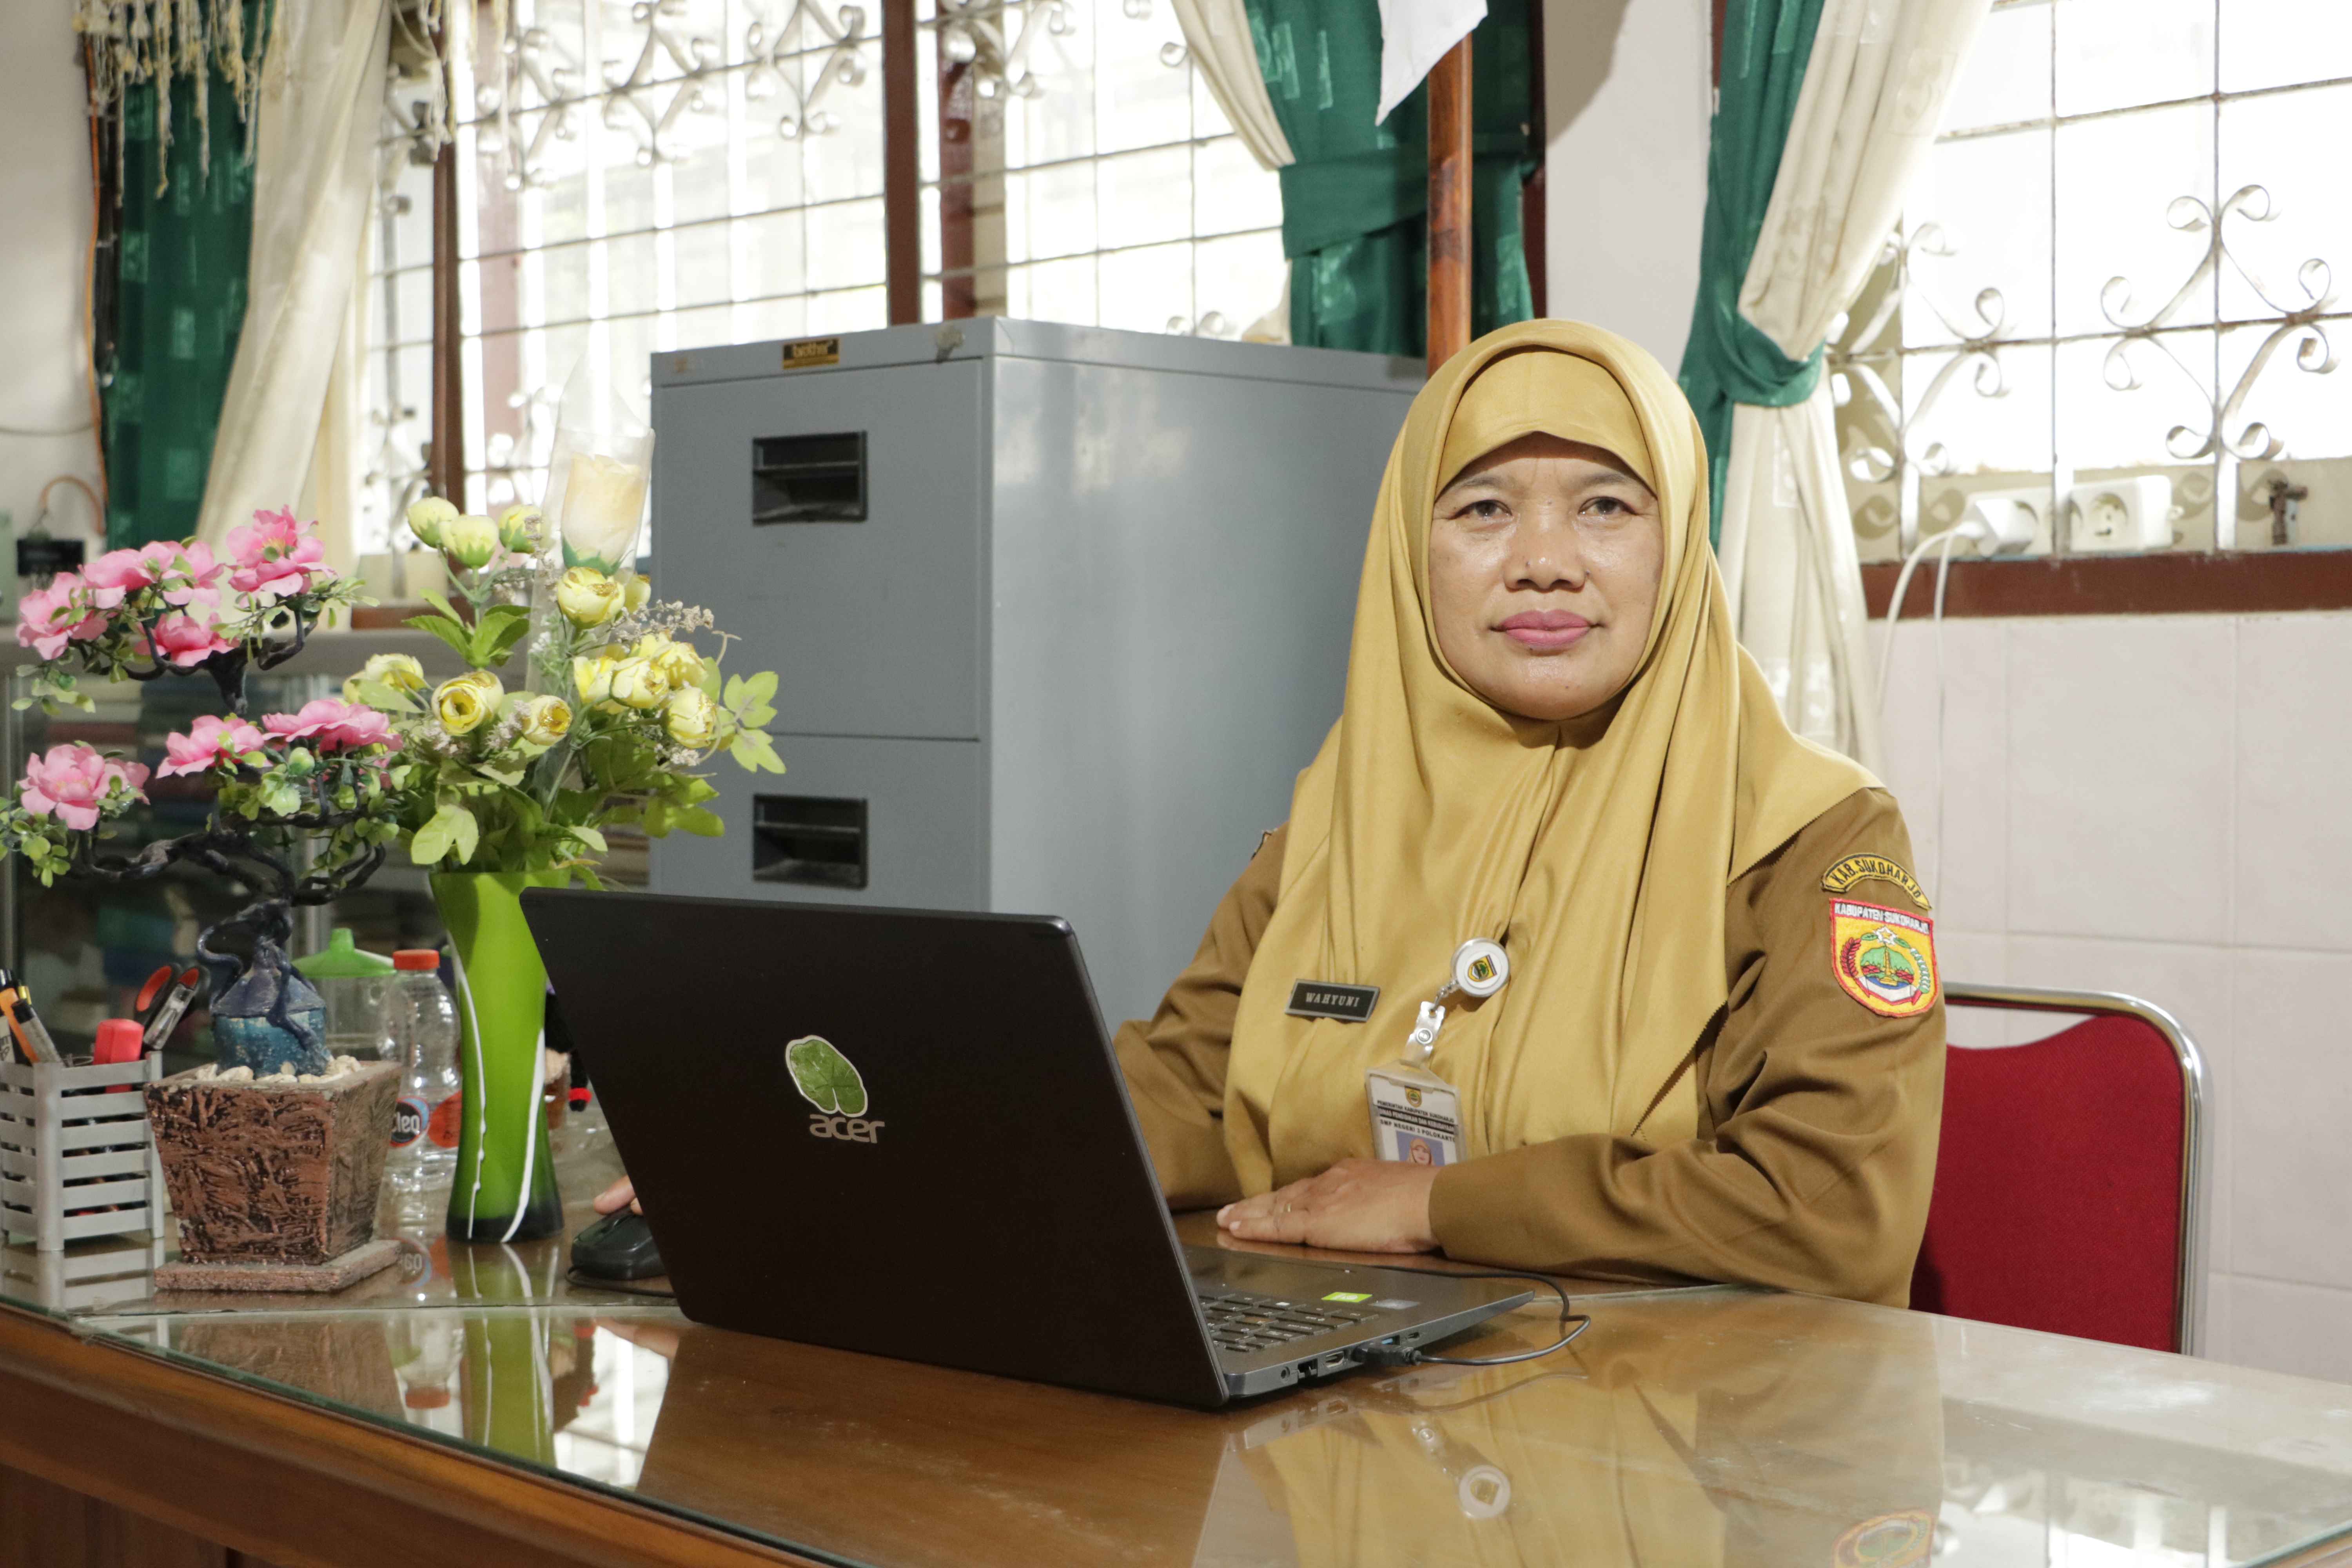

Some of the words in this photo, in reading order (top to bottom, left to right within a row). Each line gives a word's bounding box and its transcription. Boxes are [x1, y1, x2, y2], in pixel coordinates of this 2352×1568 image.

[1835, 903, 1882, 921] KABUPATEN
[1306, 993, 1359, 1007] WAHYUNI
[809, 1114, 885, 1143] acer
